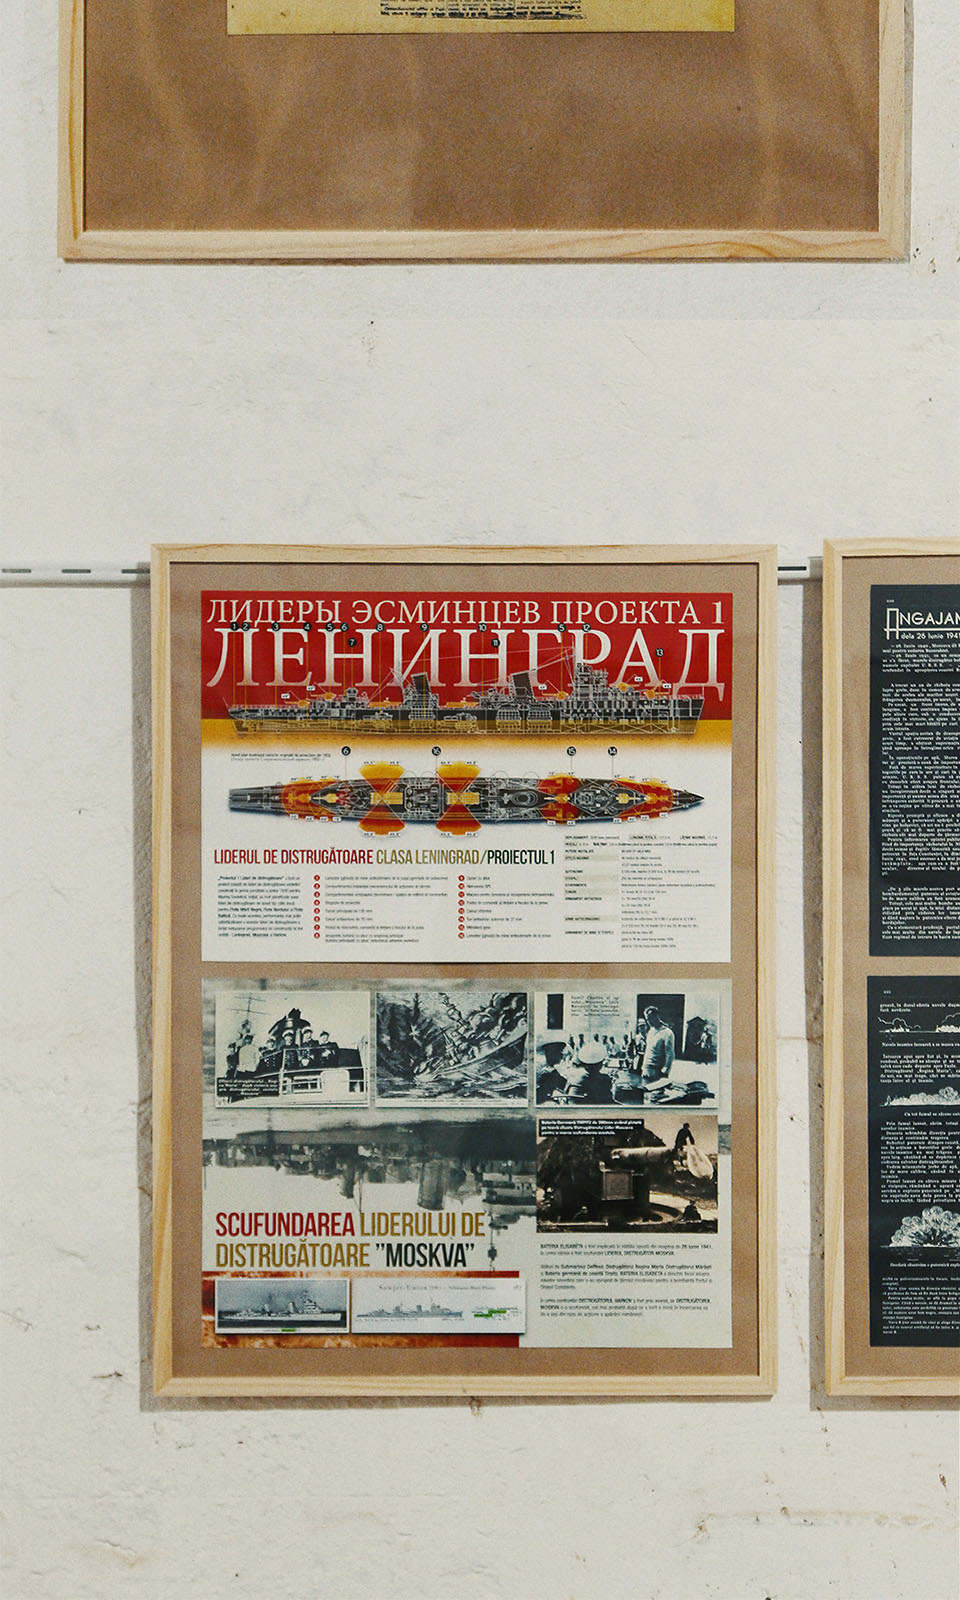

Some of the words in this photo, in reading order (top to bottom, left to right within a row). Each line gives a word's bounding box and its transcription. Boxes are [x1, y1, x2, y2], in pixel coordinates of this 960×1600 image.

[207, 600, 342, 627] ЛИДЕРЫ
[352, 600, 541, 628] ЭСМИНЦЕВ
[551, 600, 701, 625] ПРОЕКТА
[712, 601, 725, 625] 1
[901, 632, 915, 640] dela
[917, 632, 926, 640] 26
[928, 632, 944, 640] Iunie
[206, 628, 726, 702] ЛЕНИНГРАД
[214, 850, 260, 864] LIDERUL
[263, 850, 278, 864] DE
[281, 847, 374, 864] DISTRUGĂTOARE
[376, 850, 414, 864] CLASA
[550, 850, 556, 864] 1
[215, 1212, 355, 1237] SCUFUNDAREA
[360, 1212, 456, 1237] LIDERULUI
[461, 1212, 486, 1237] DE
[216, 1238, 370, 1268] DISTRUGĂTOARE
